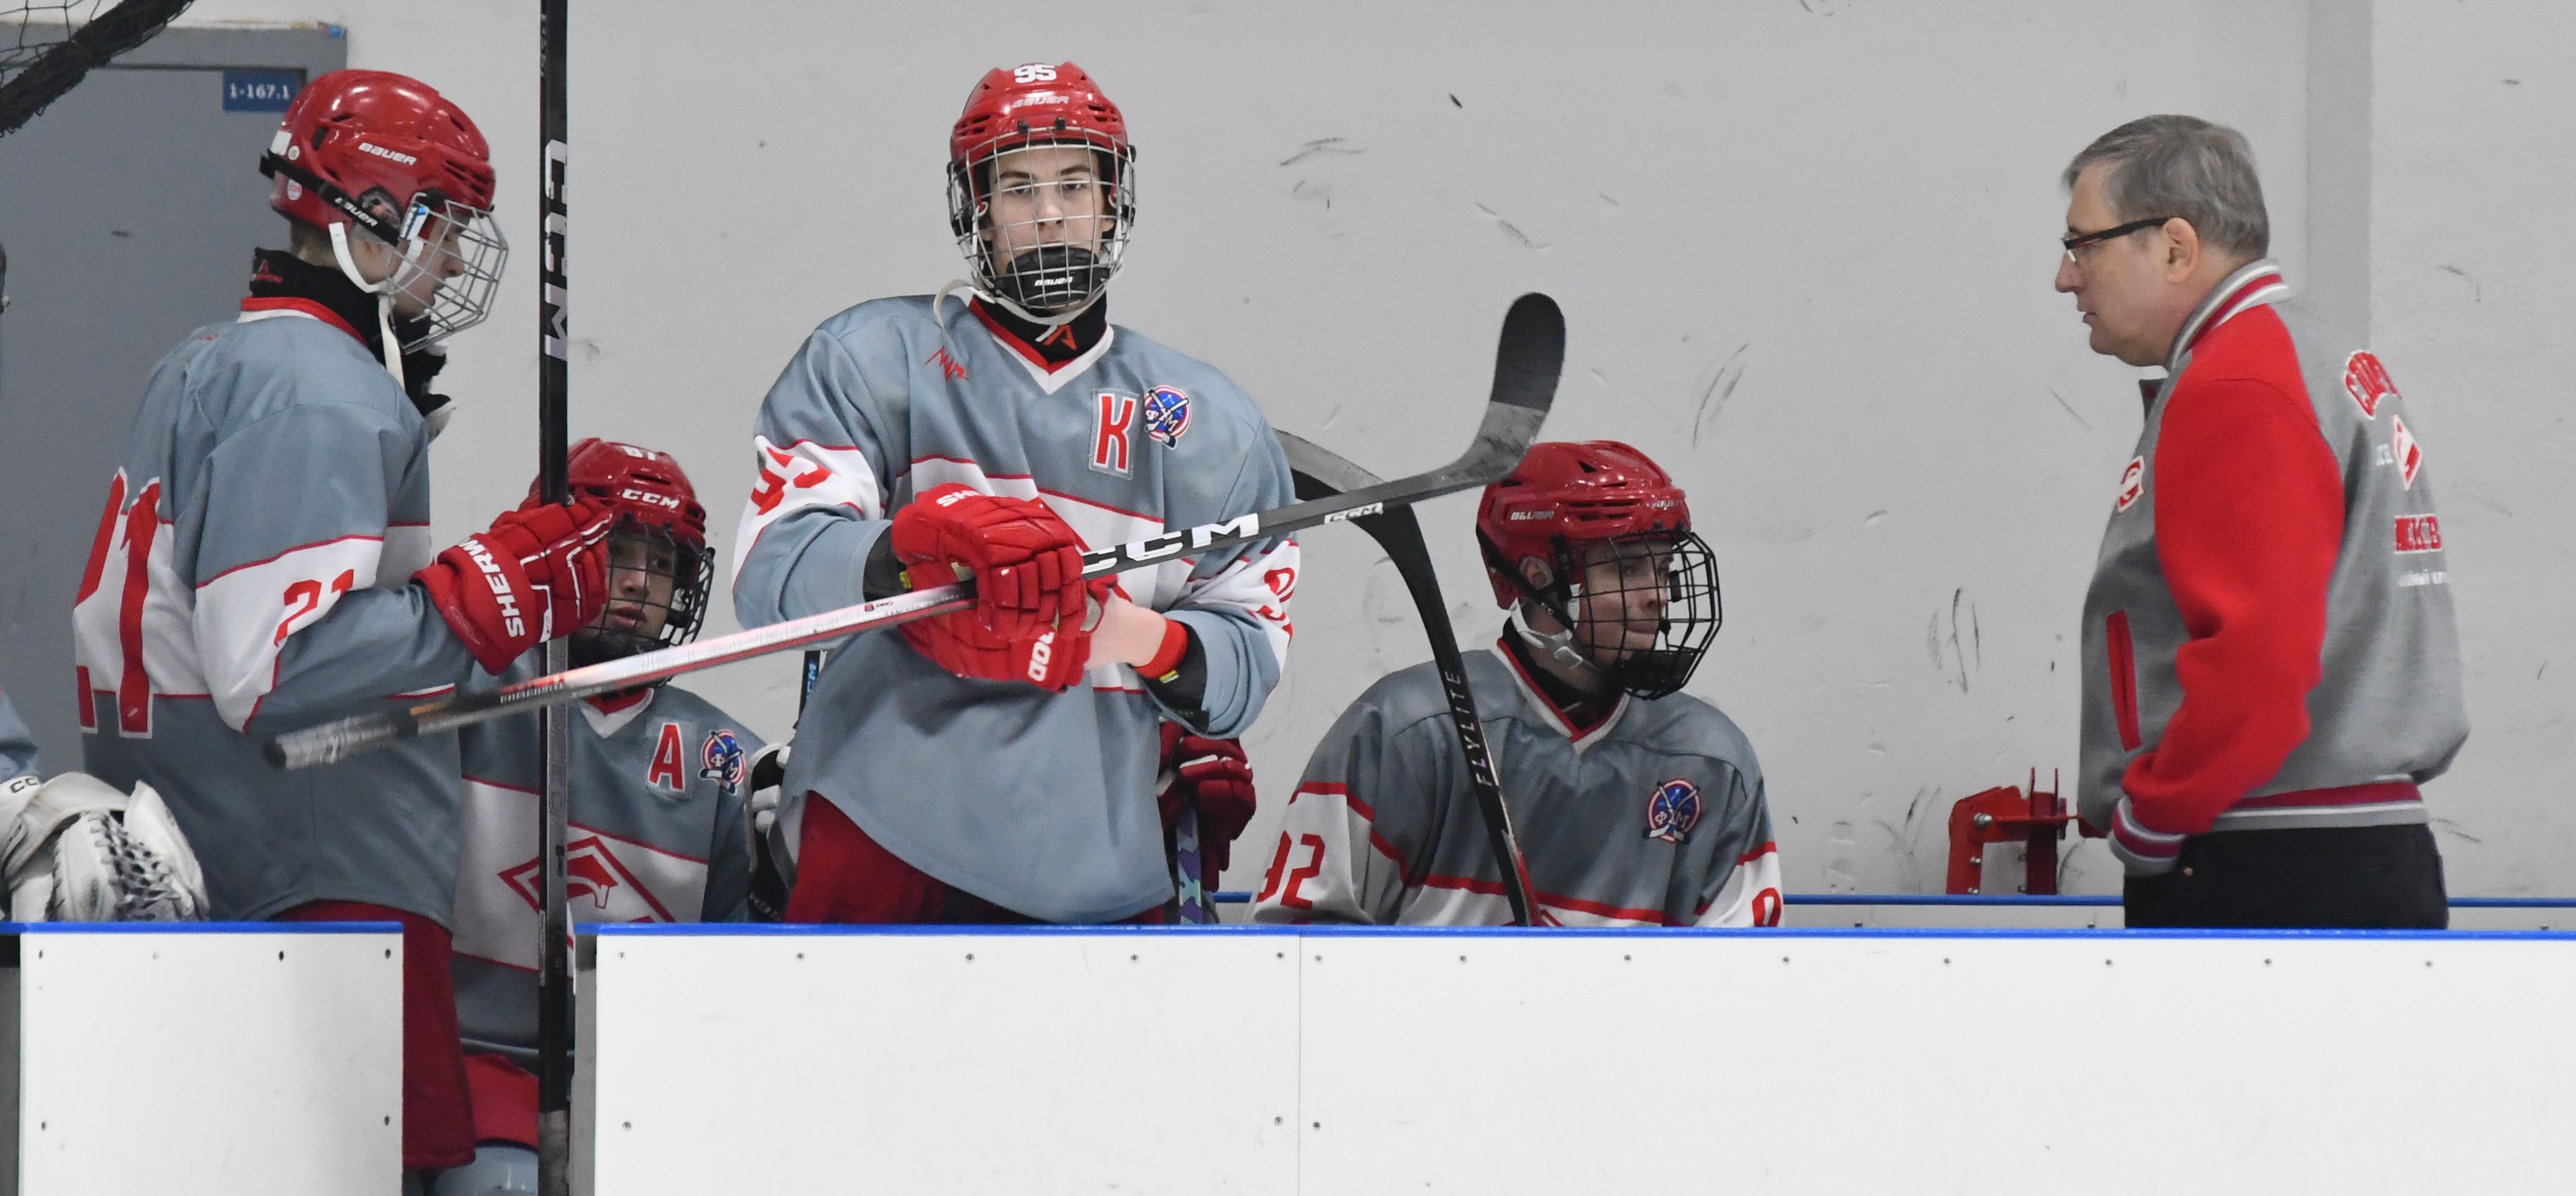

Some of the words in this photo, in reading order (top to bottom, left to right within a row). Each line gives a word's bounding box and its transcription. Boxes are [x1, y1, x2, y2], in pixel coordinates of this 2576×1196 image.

[1014, 64, 1057, 83] 95
[230, 83, 290, 100] 1-167.1
[358, 142, 418, 165] BAUER
[545, 139, 567, 361] CCM
[1035, 276, 1073, 286] BAUER
[622, 488, 679, 509] CCM
[1082, 513, 1259, 574] CCM
[1444, 671, 1493, 787] FLYLITE
